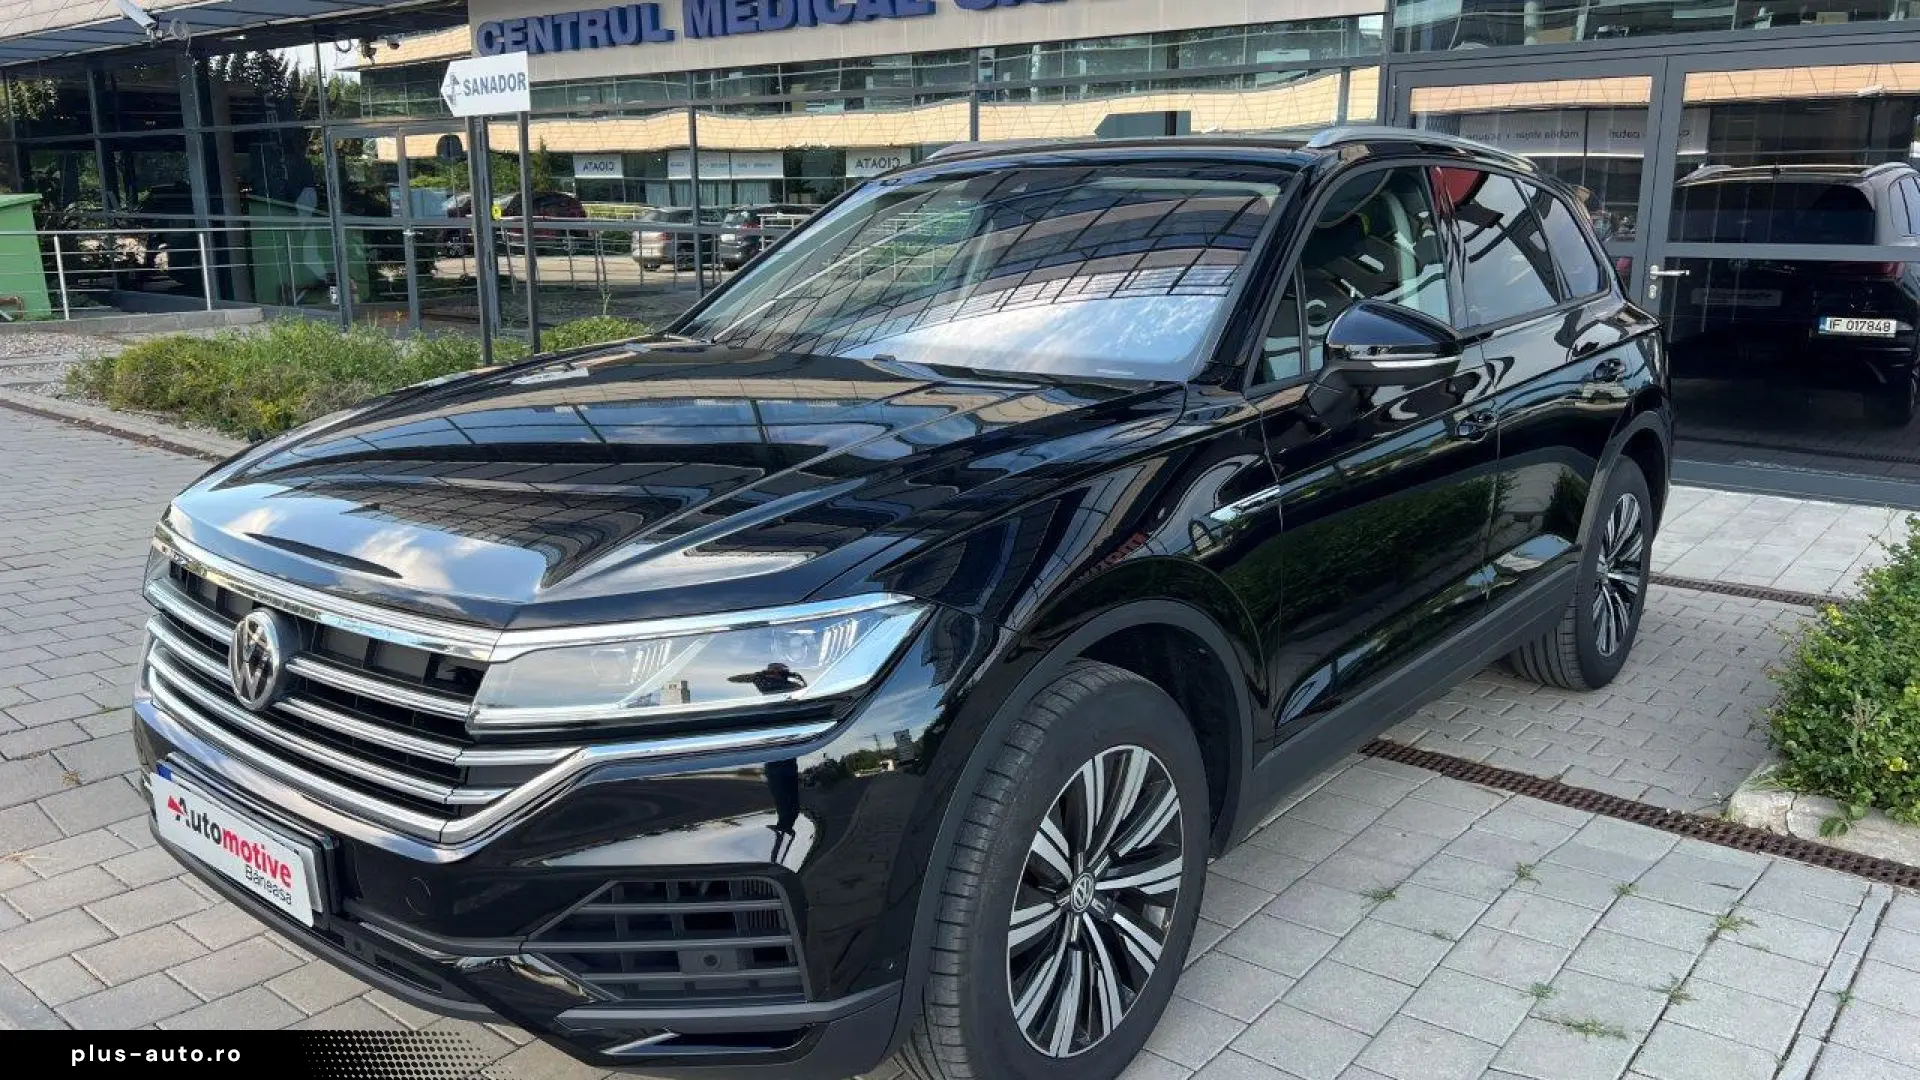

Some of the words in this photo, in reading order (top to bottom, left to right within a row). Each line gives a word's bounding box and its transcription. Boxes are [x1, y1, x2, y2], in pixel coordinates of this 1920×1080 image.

[476, 3, 675, 57] CENTRUL
[463, 71, 527, 97] SANADOR
[1829, 318, 1843, 331] IF
[1846, 320, 1891, 332] 017848
[168, 795, 292, 889] Automotive
